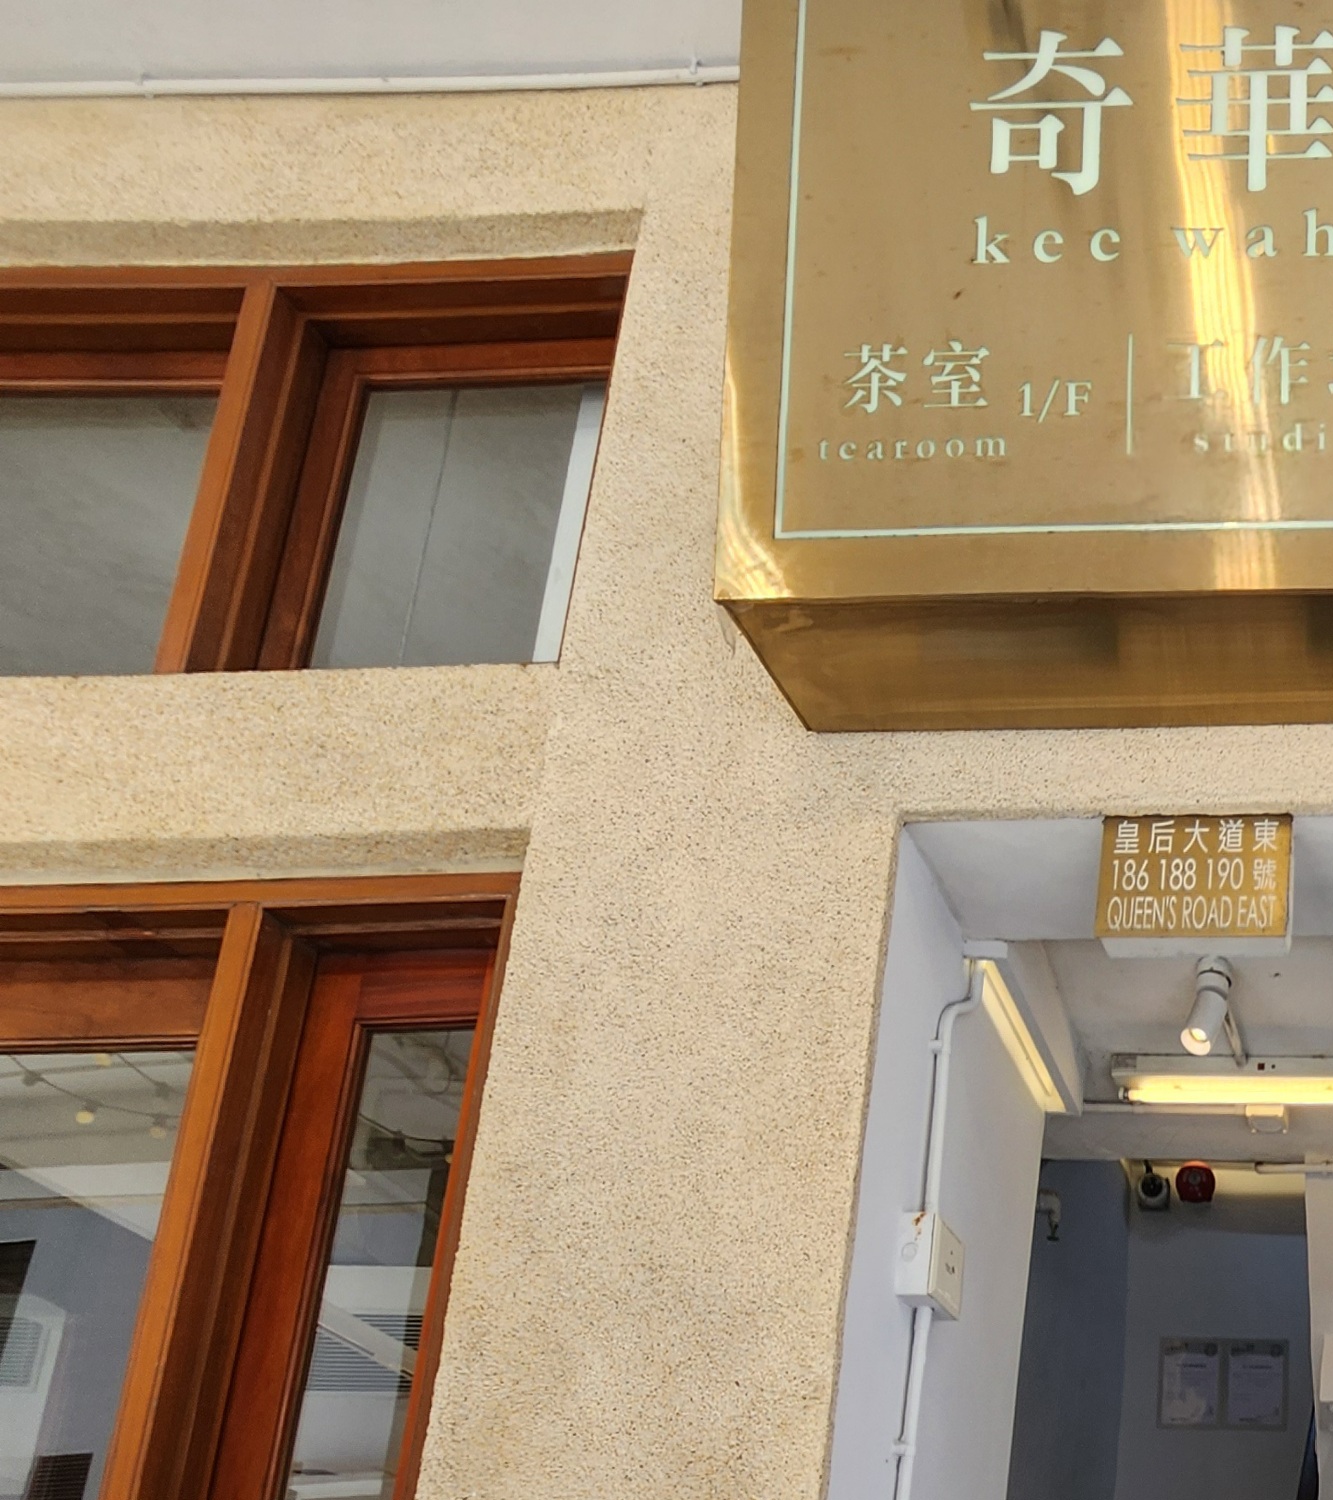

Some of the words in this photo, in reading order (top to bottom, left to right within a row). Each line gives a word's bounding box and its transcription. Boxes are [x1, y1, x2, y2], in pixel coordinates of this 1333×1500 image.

[973, 216, 1122, 265] kee
[843, 340, 990, 414] 茶室
[1017, 380, 1092, 423] 1/F
[818, 434, 1008, 462] tearoom
[1113, 819, 1279, 854] 皇后大道東
[1113, 858, 1149, 891] 186
[1159, 858, 1197, 891] 188
[1207, 858, 1244, 890] 190
[1252, 858, 1277, 891] 號
[1107, 896, 1177, 931] QUEEN'S
[1182, 896, 1232, 929] ROAD
[1237, 896, 1277, 928] EAST
